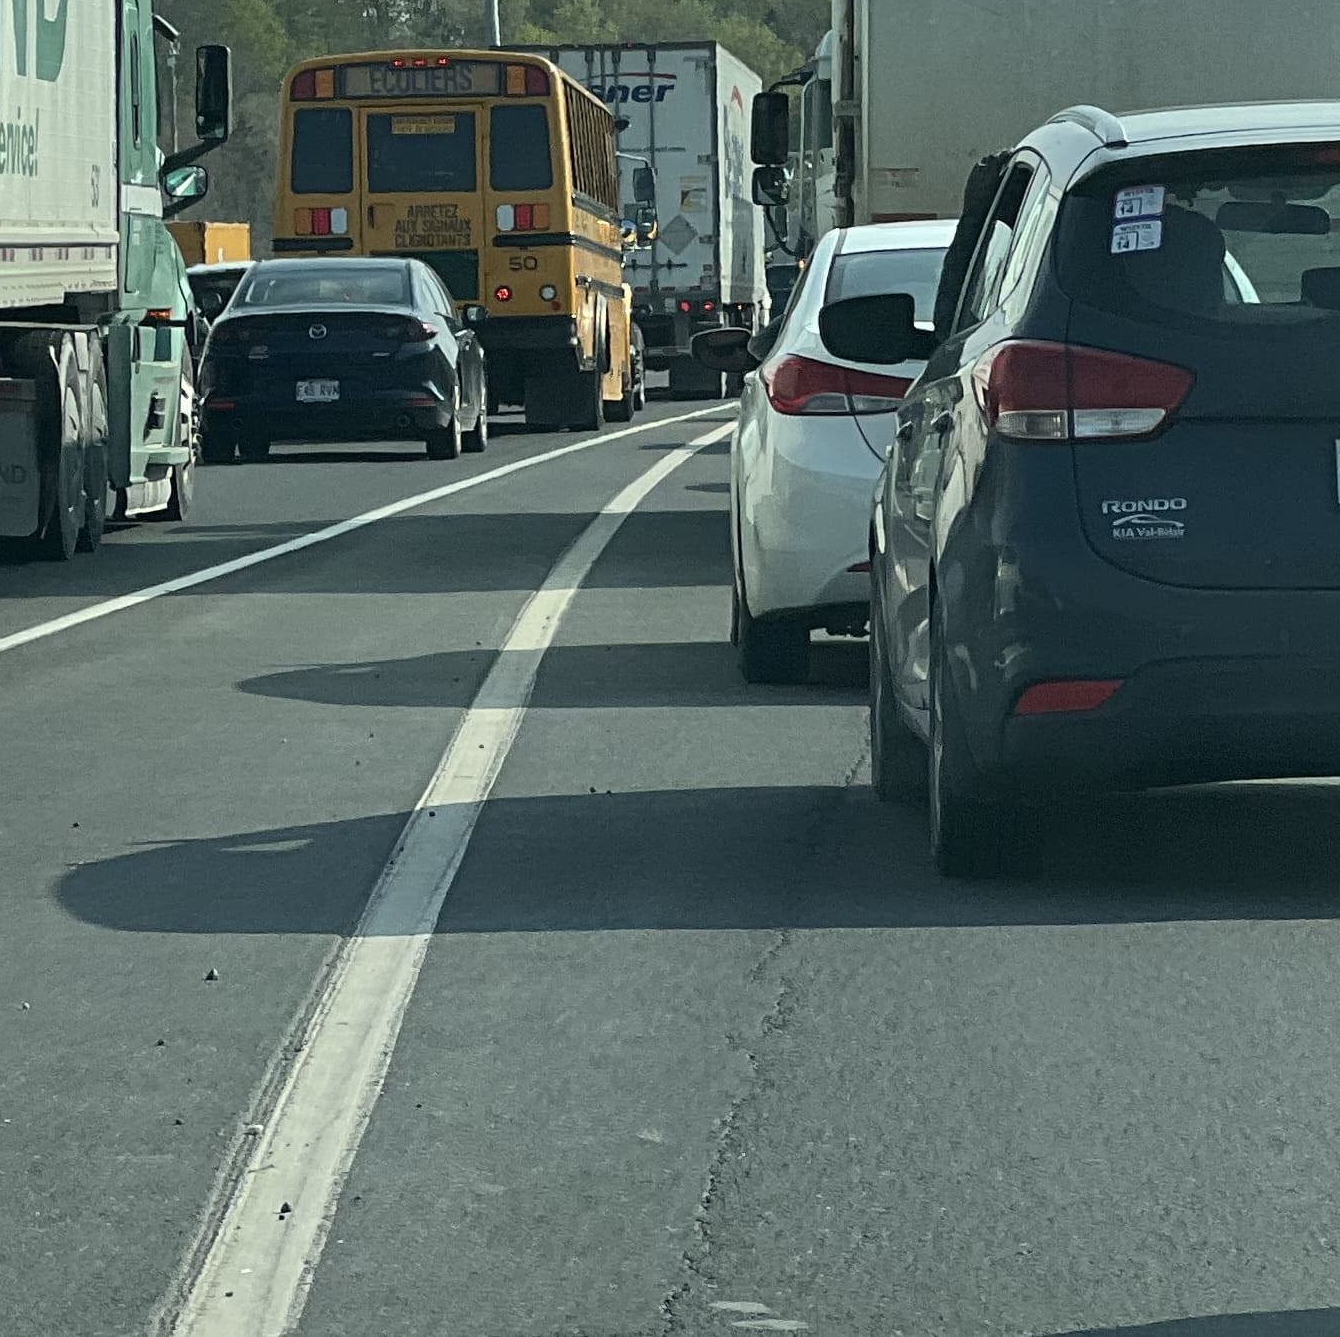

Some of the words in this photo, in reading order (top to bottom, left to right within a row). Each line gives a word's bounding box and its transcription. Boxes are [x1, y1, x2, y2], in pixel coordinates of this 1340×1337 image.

[395, 219, 418, 233] AUX
[423, 218, 472, 234] SIGNAUX
[394, 233, 472, 248] CLIGNOTANTS
[1101, 497, 1188, 515] RONDO
[1112, 527, 1135, 539] KIA
